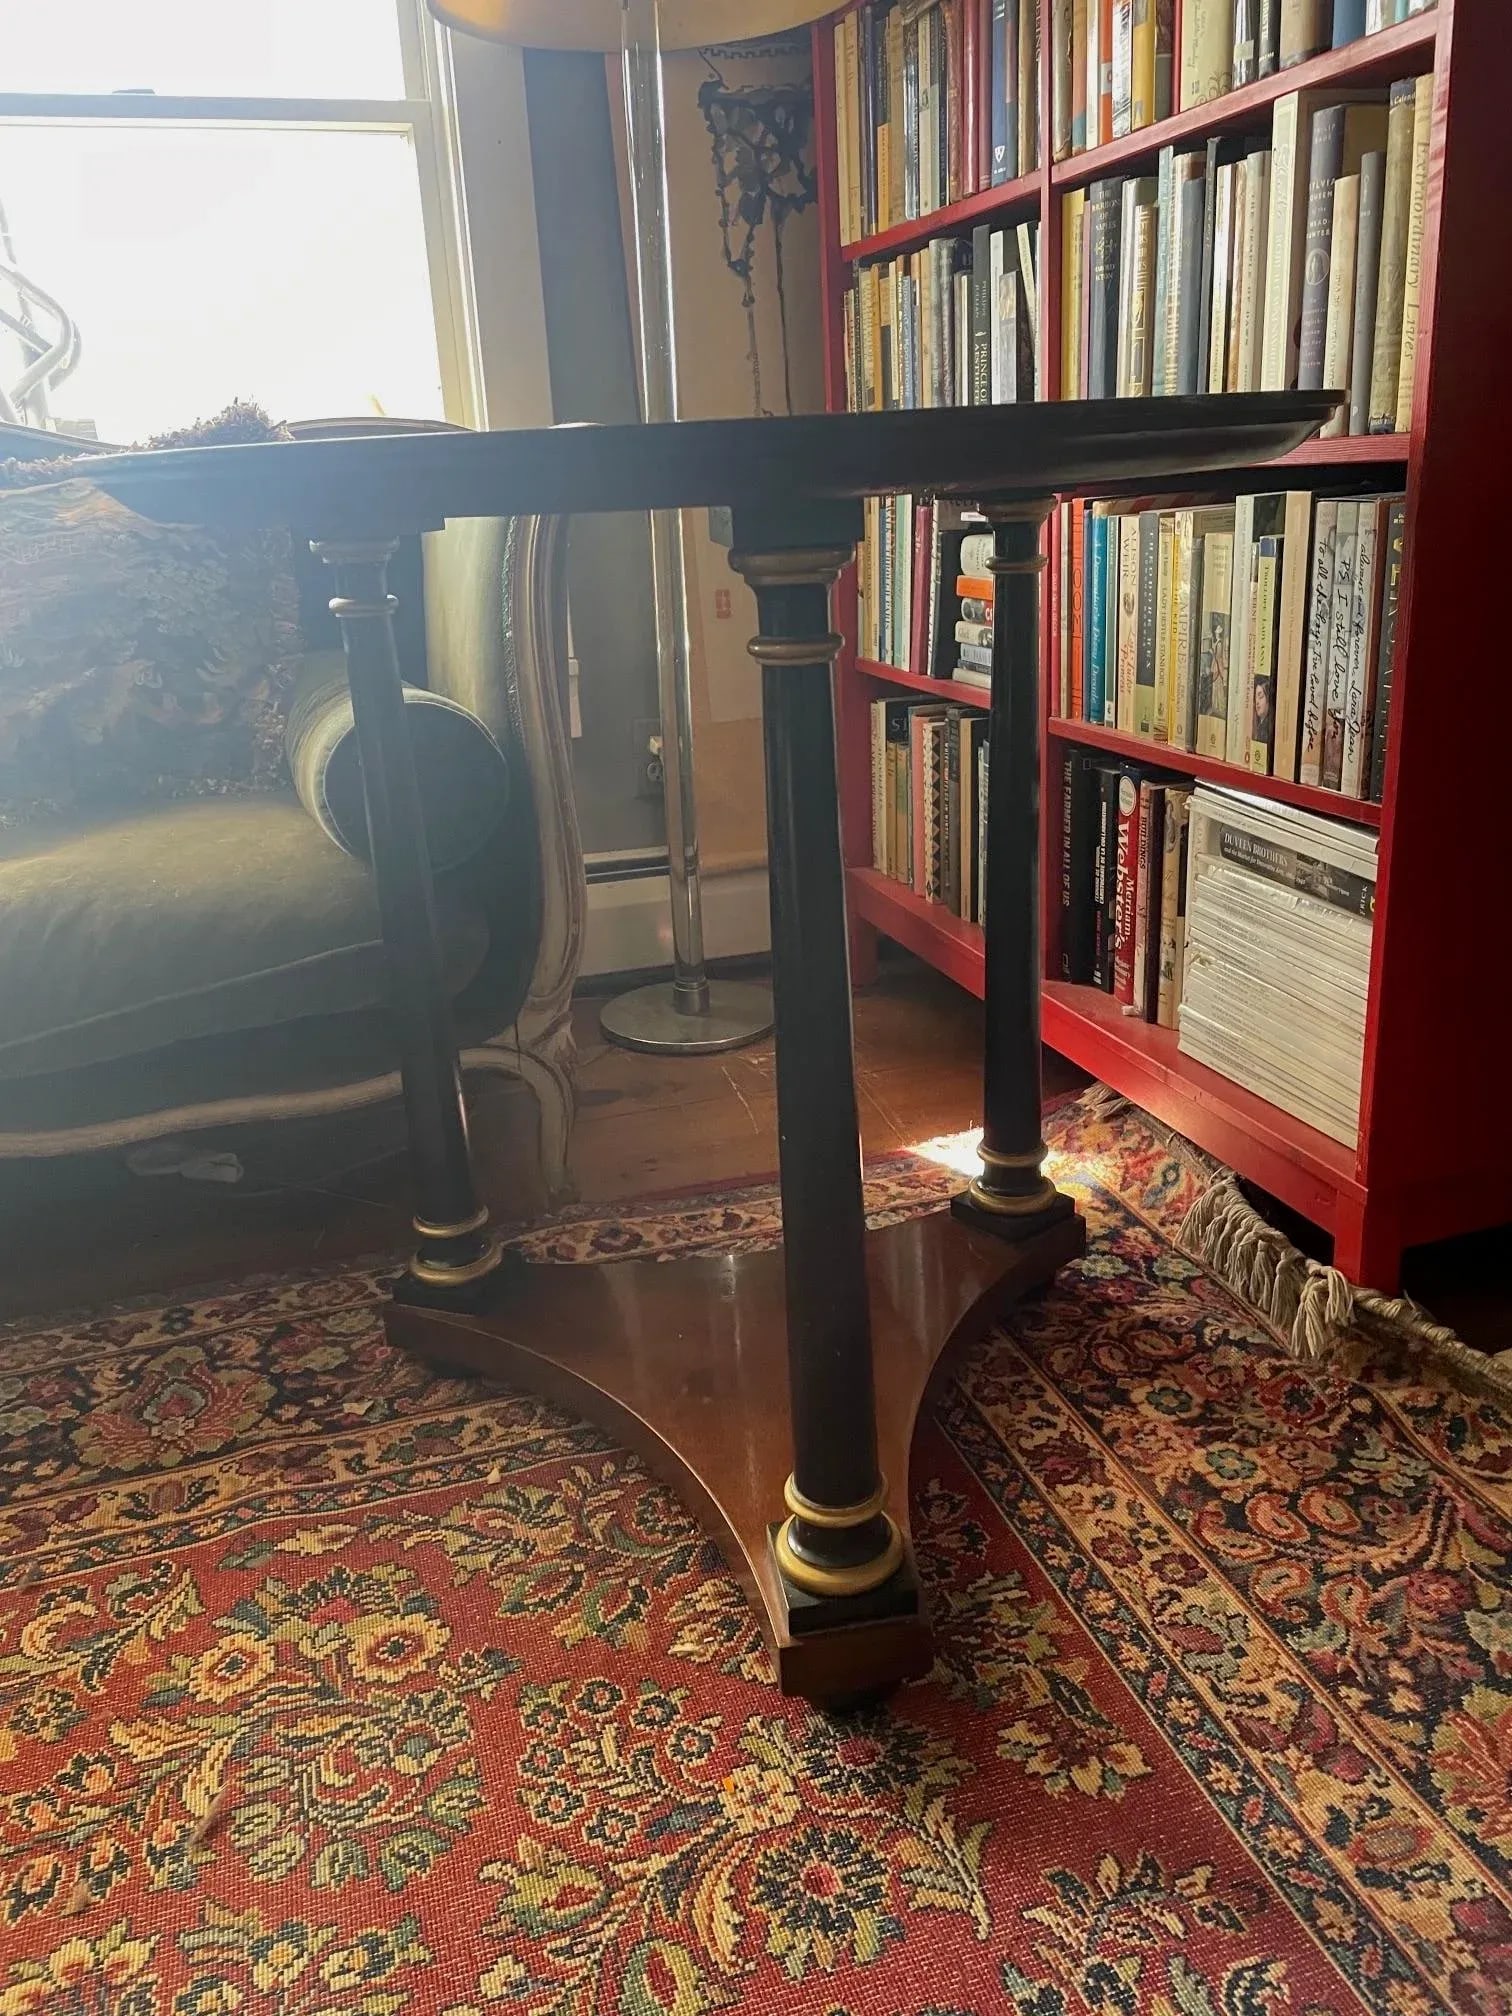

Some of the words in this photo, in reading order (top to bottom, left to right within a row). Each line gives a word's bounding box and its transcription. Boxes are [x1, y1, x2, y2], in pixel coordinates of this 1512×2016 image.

[1407, 142, 1430, 289] Extraordinary
[1404, 303, 1421, 360] Lives
[980, 343, 988, 388] PRINCE
[1122, 538, 1130, 580] WEIR
[1317, 558, 1328, 579] all
[1352, 544, 1371, 594] always
[1146, 532, 1154, 628] THEODORE
[1337, 589, 1349, 607] I
[1310, 611, 1326, 646] boys
[1334, 611, 1348, 652] still
[1159, 643, 1167, 686] STANHOPE
[1331, 661, 1345, 702] love
[1309, 673, 1320, 704] loved
[1348, 681, 1363, 719] Lara
[1306, 710, 1319, 752] before
[1327, 709, 1343, 740] you
[1345, 719, 1361, 763] Jean
[1064, 761, 1073, 784] THE
[1063, 787, 1073, 834] FARMER
[1063, 850, 1071, 873] ALL
[1139, 816, 1148, 870] BUILDINGS
[1223, 832, 1254, 852] DUVEEN
[1252, 839, 1288, 866] BROTHERS
[1062, 891, 1071, 907] US
[1114, 820, 1131, 950] Webster's
